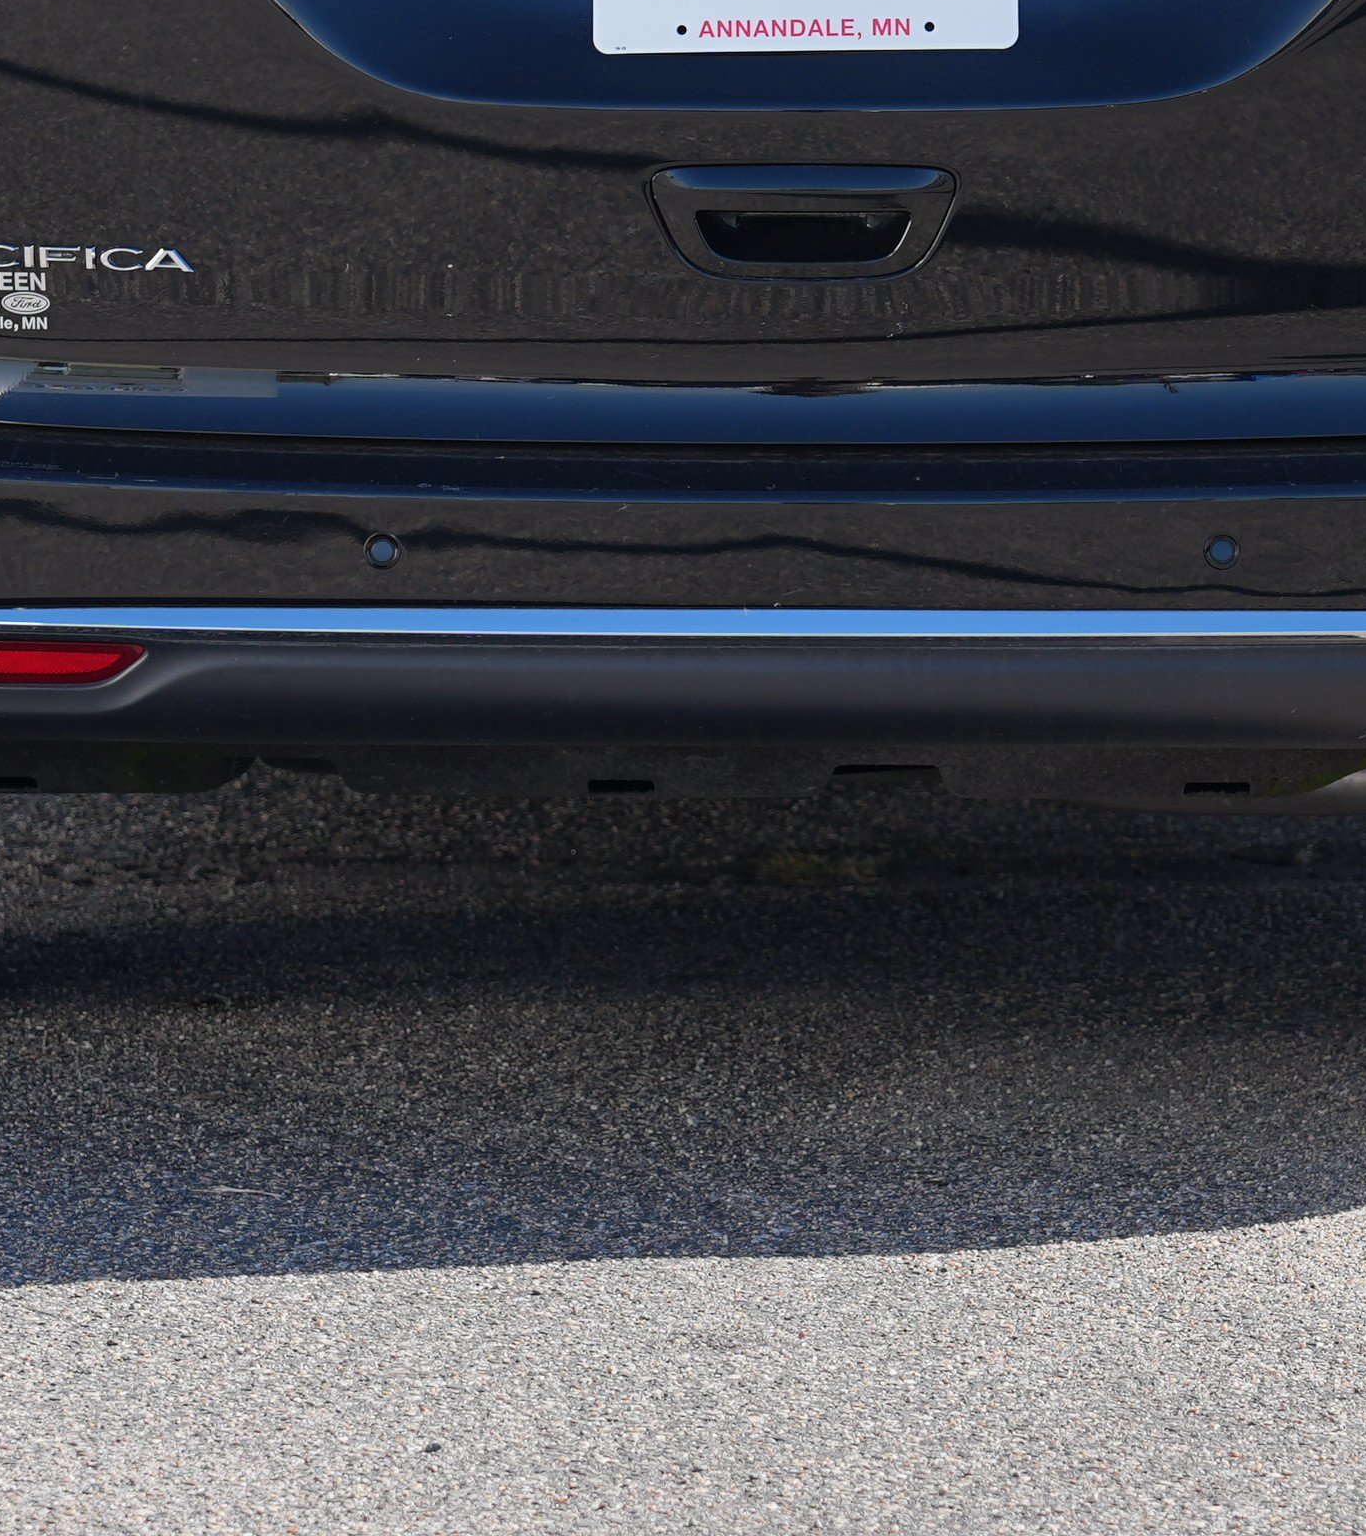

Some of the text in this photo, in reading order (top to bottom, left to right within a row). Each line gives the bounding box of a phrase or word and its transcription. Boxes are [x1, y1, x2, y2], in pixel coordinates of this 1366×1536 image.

[698, 18, 911, 40] ANNANDALE, MN
[10, 296, 42, 309] Ford
[21, 315, 48, 330] MN
